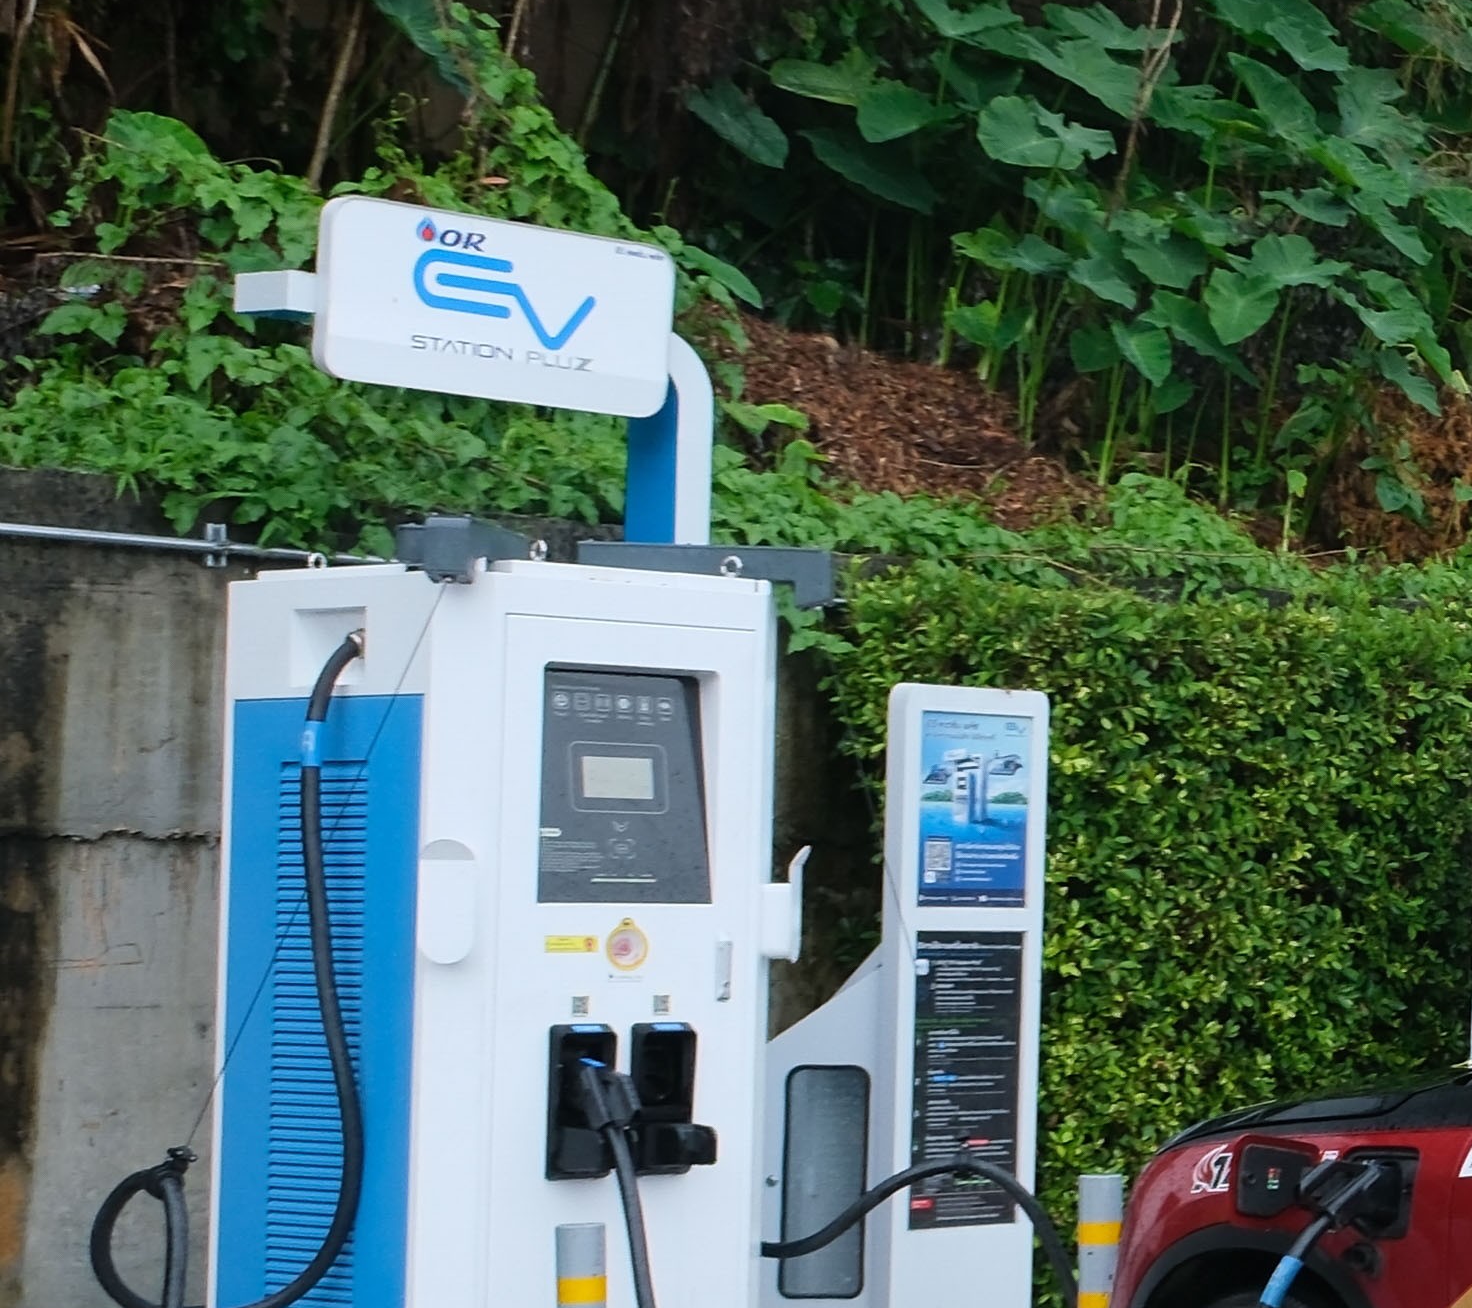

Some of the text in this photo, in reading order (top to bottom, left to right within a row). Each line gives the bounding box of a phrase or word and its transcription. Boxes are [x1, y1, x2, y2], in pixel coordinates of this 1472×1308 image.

[439, 229, 486, 252] OR
[413, 248, 596, 350] EV
[411, 334, 596, 372] STATION PLUZ
